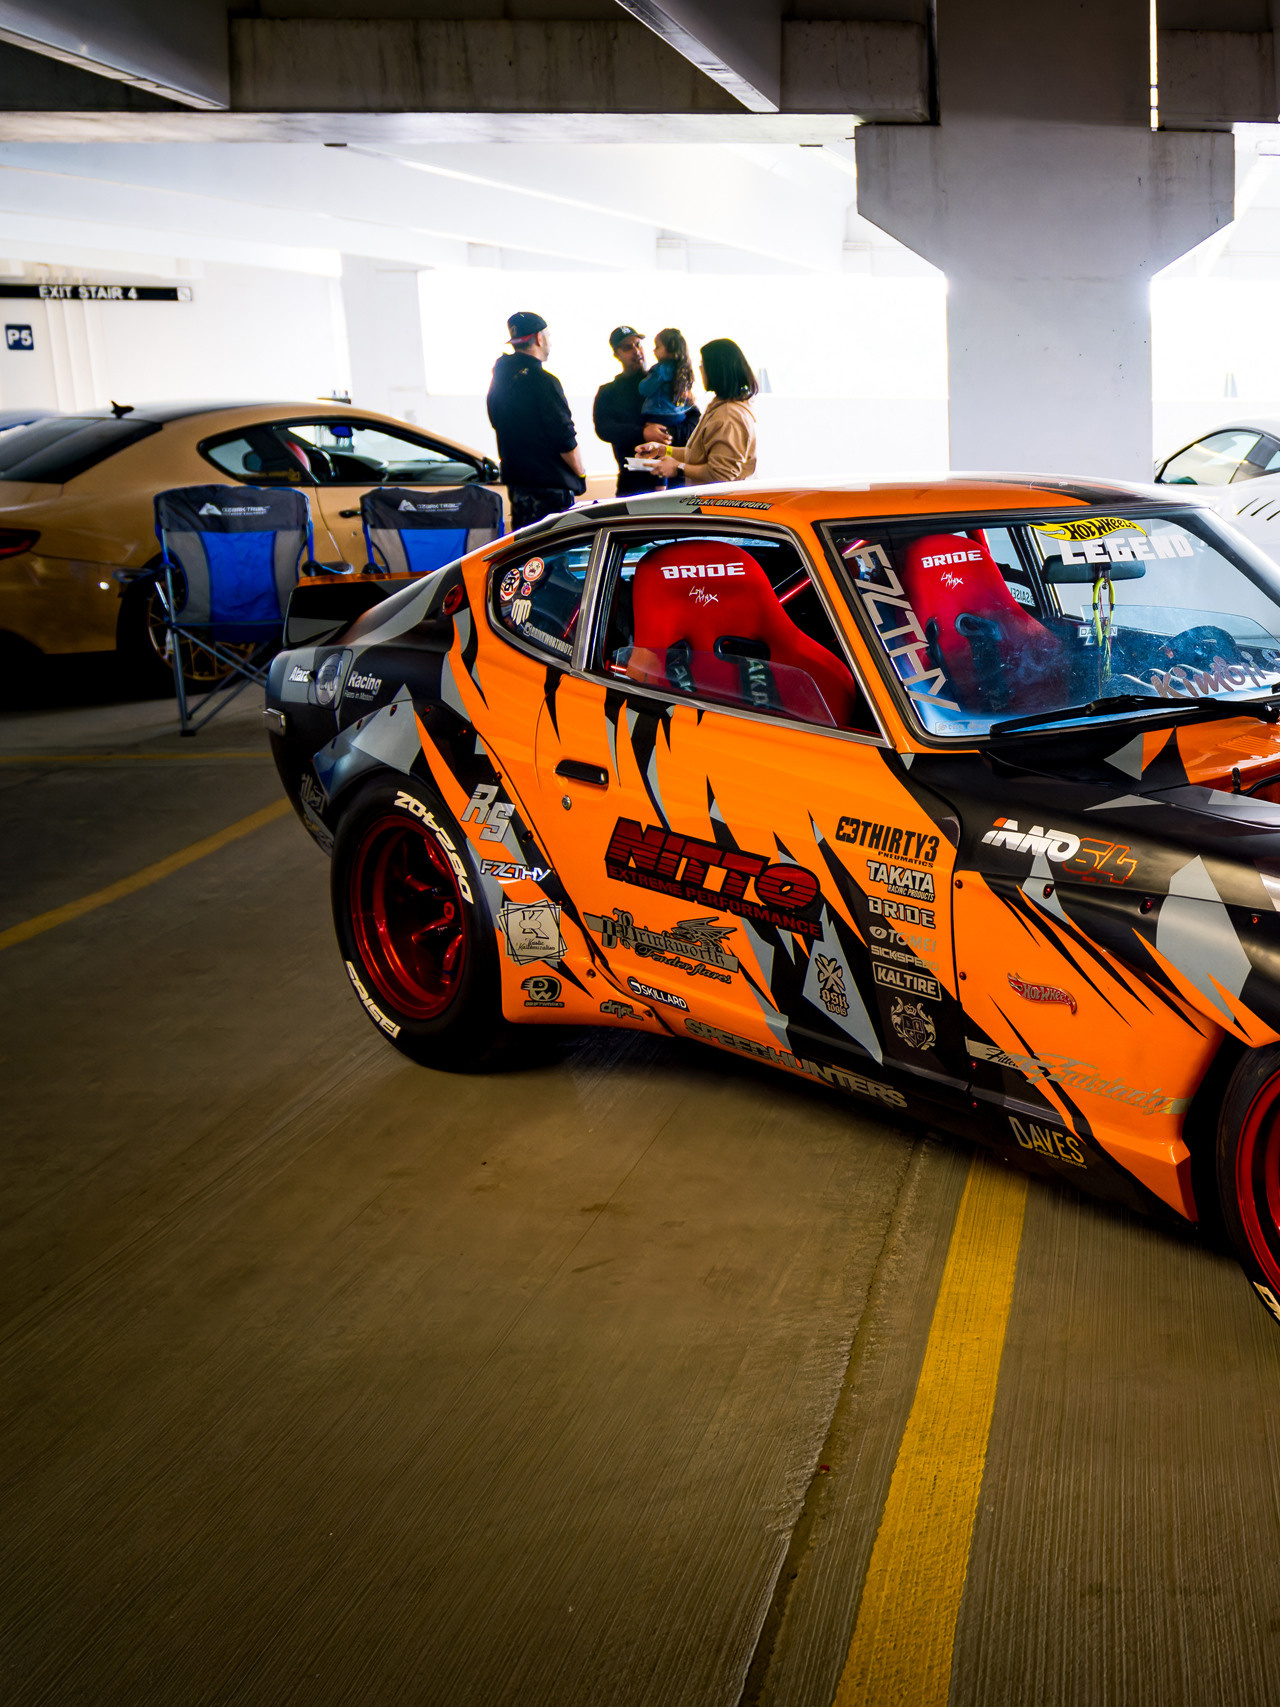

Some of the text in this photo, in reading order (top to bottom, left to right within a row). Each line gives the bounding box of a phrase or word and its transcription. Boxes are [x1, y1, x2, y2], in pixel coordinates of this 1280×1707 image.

[38, 285, 138, 300] EXIT STAIR 4
[7, 329, 33, 346] P5
[921, 550, 983, 569] BRIDE
[1058, 534, 1194, 566] LEGEND
[660, 562, 746, 579] BRIDE
[348, 671, 382, 696] Racing
[606, 818, 819, 909] NITTO
[878, 851, 934, 868] PNEUMATICS
[867, 860, 934, 893] TAKATA
[609, 866, 821, 937] EXTREME PERFORMANCE
[907, 888, 935, 901] PRODUCTS
[868, 896, 936, 929] BRIDE
[888, 928, 936, 953] TOMEI
[871, 945, 939, 971] SICKSPEED
[684, 1018, 908, 1108] SPEEDHUNTERS
[1008, 1116, 1085, 1163] DAVES
